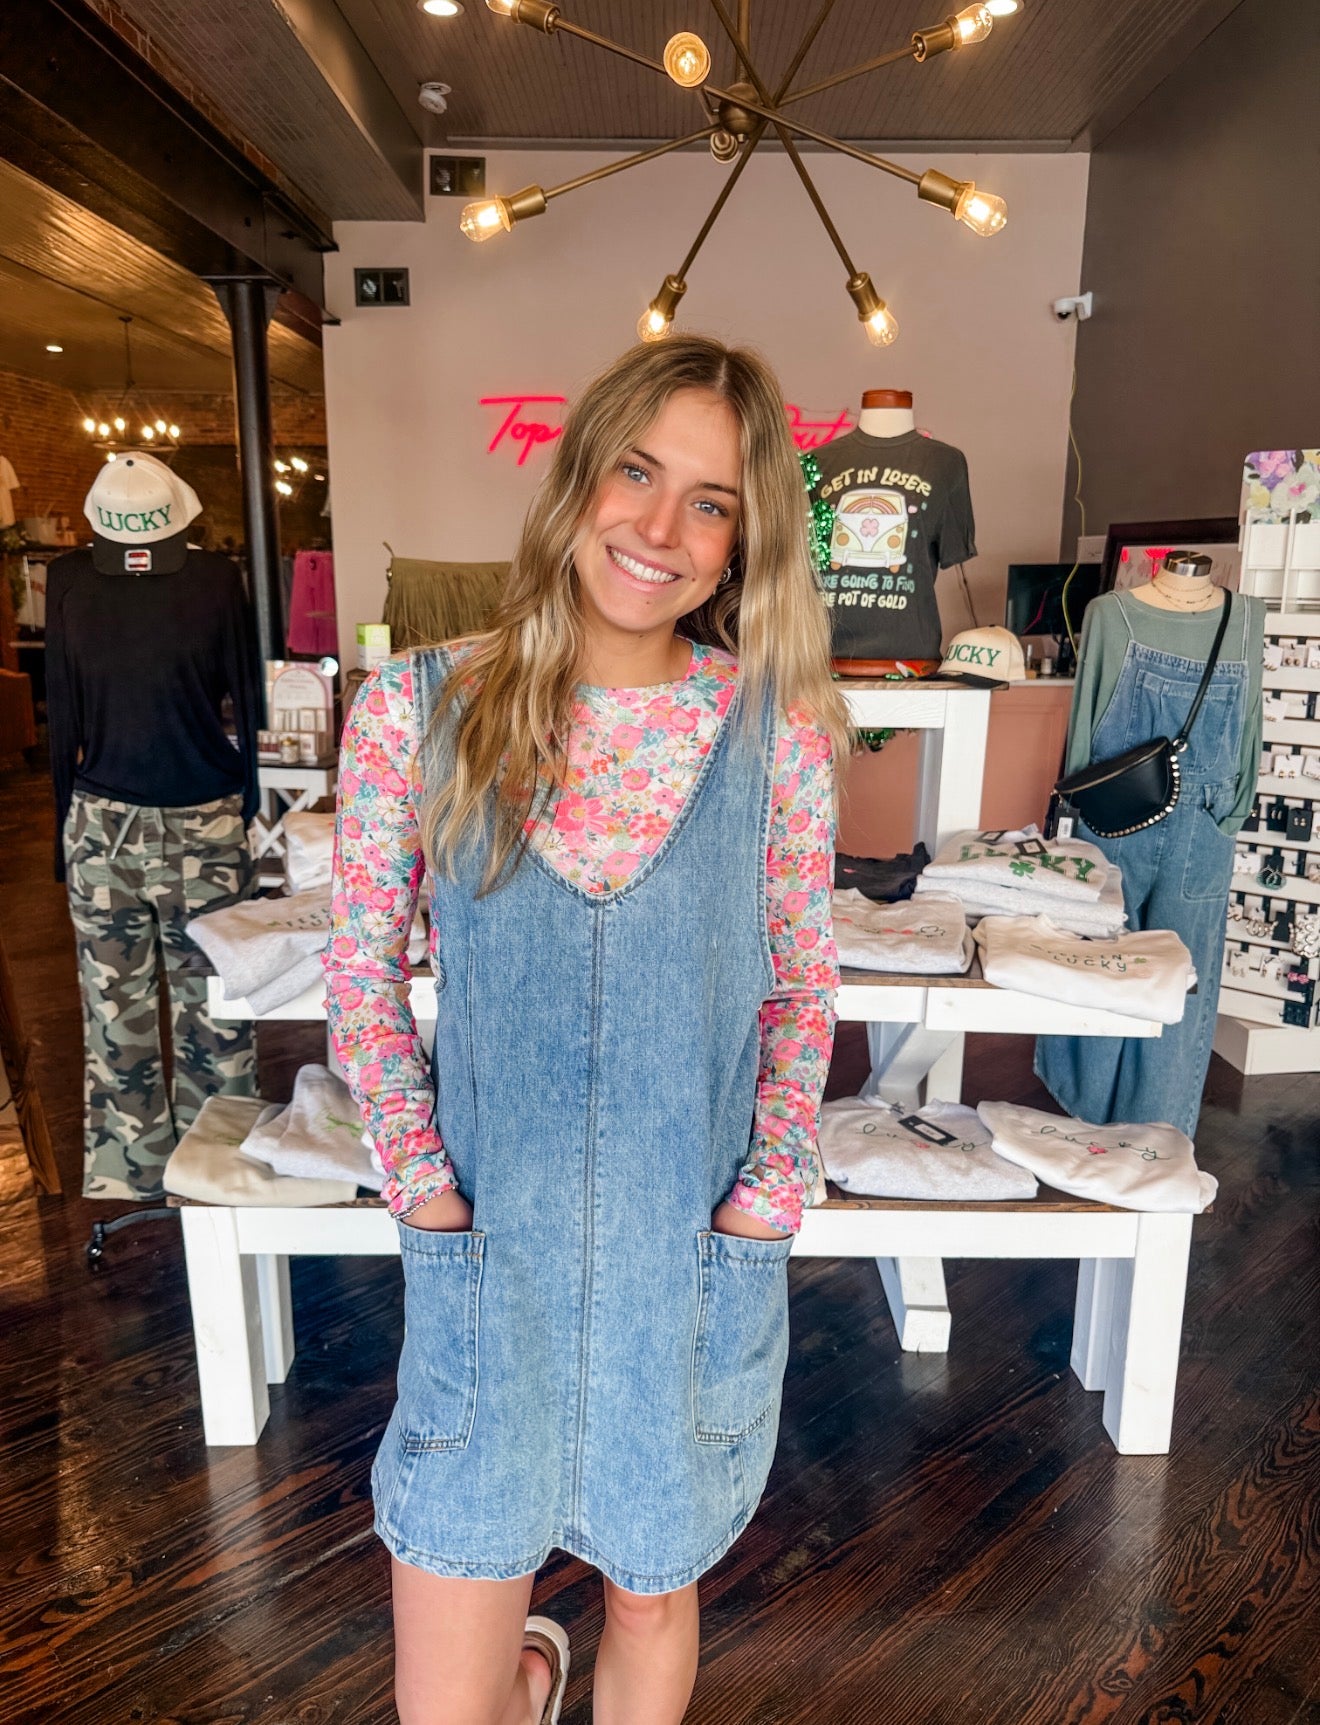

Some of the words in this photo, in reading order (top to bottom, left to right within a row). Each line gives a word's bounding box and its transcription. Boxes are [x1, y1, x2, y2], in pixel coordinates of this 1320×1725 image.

[479, 395, 566, 467] Top
[820, 468, 855, 499] GET
[856, 466, 879, 485] IN
[880, 467, 932, 497] LOSER
[97, 504, 171, 533] LUCKY
[840, 573, 879, 590] GOING
[881, 575, 894, 591] TO
[896, 576, 916, 594] FIND
[837, 590, 861, 606] POT
[861, 592, 877, 608] OF
[877, 593, 908, 610] GOLD
